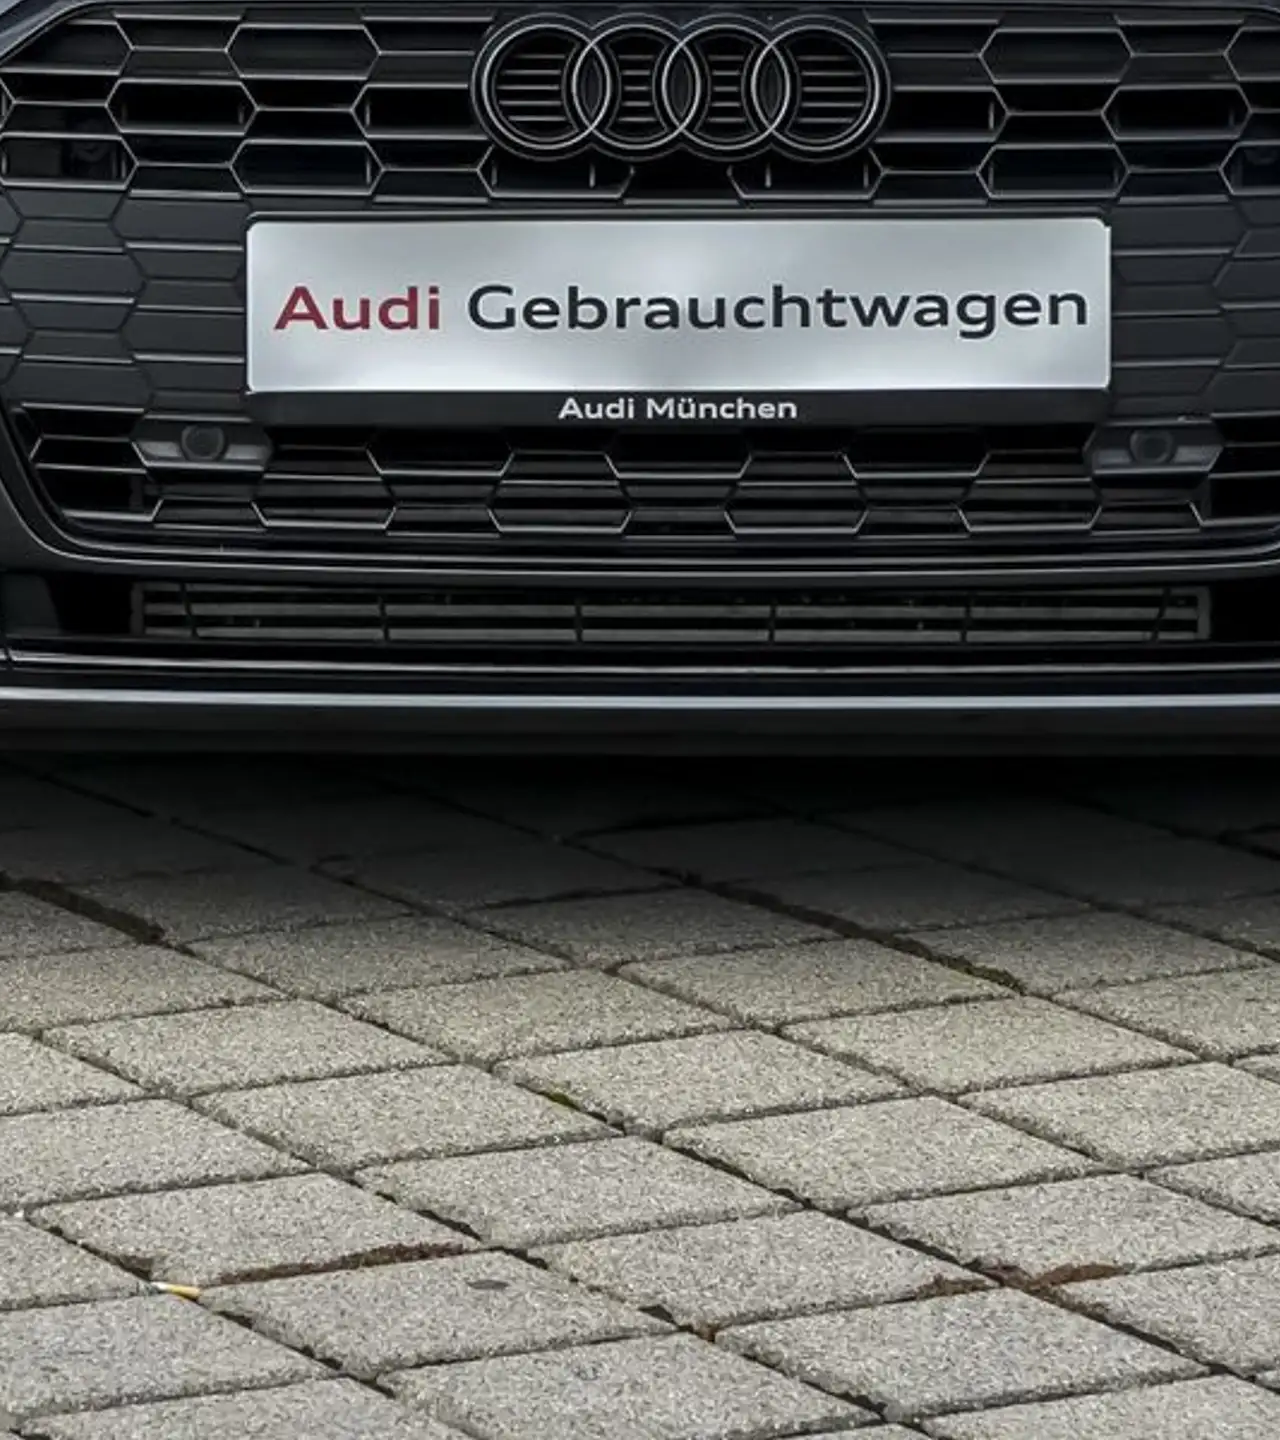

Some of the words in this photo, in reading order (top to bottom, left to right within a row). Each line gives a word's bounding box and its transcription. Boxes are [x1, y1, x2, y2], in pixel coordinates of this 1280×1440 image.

[274, 284, 440, 331] Audi
[467, 284, 1088, 340] Gebrauchtwagen
[558, 397, 635, 420] Audi
[646, 397, 798, 420] München
